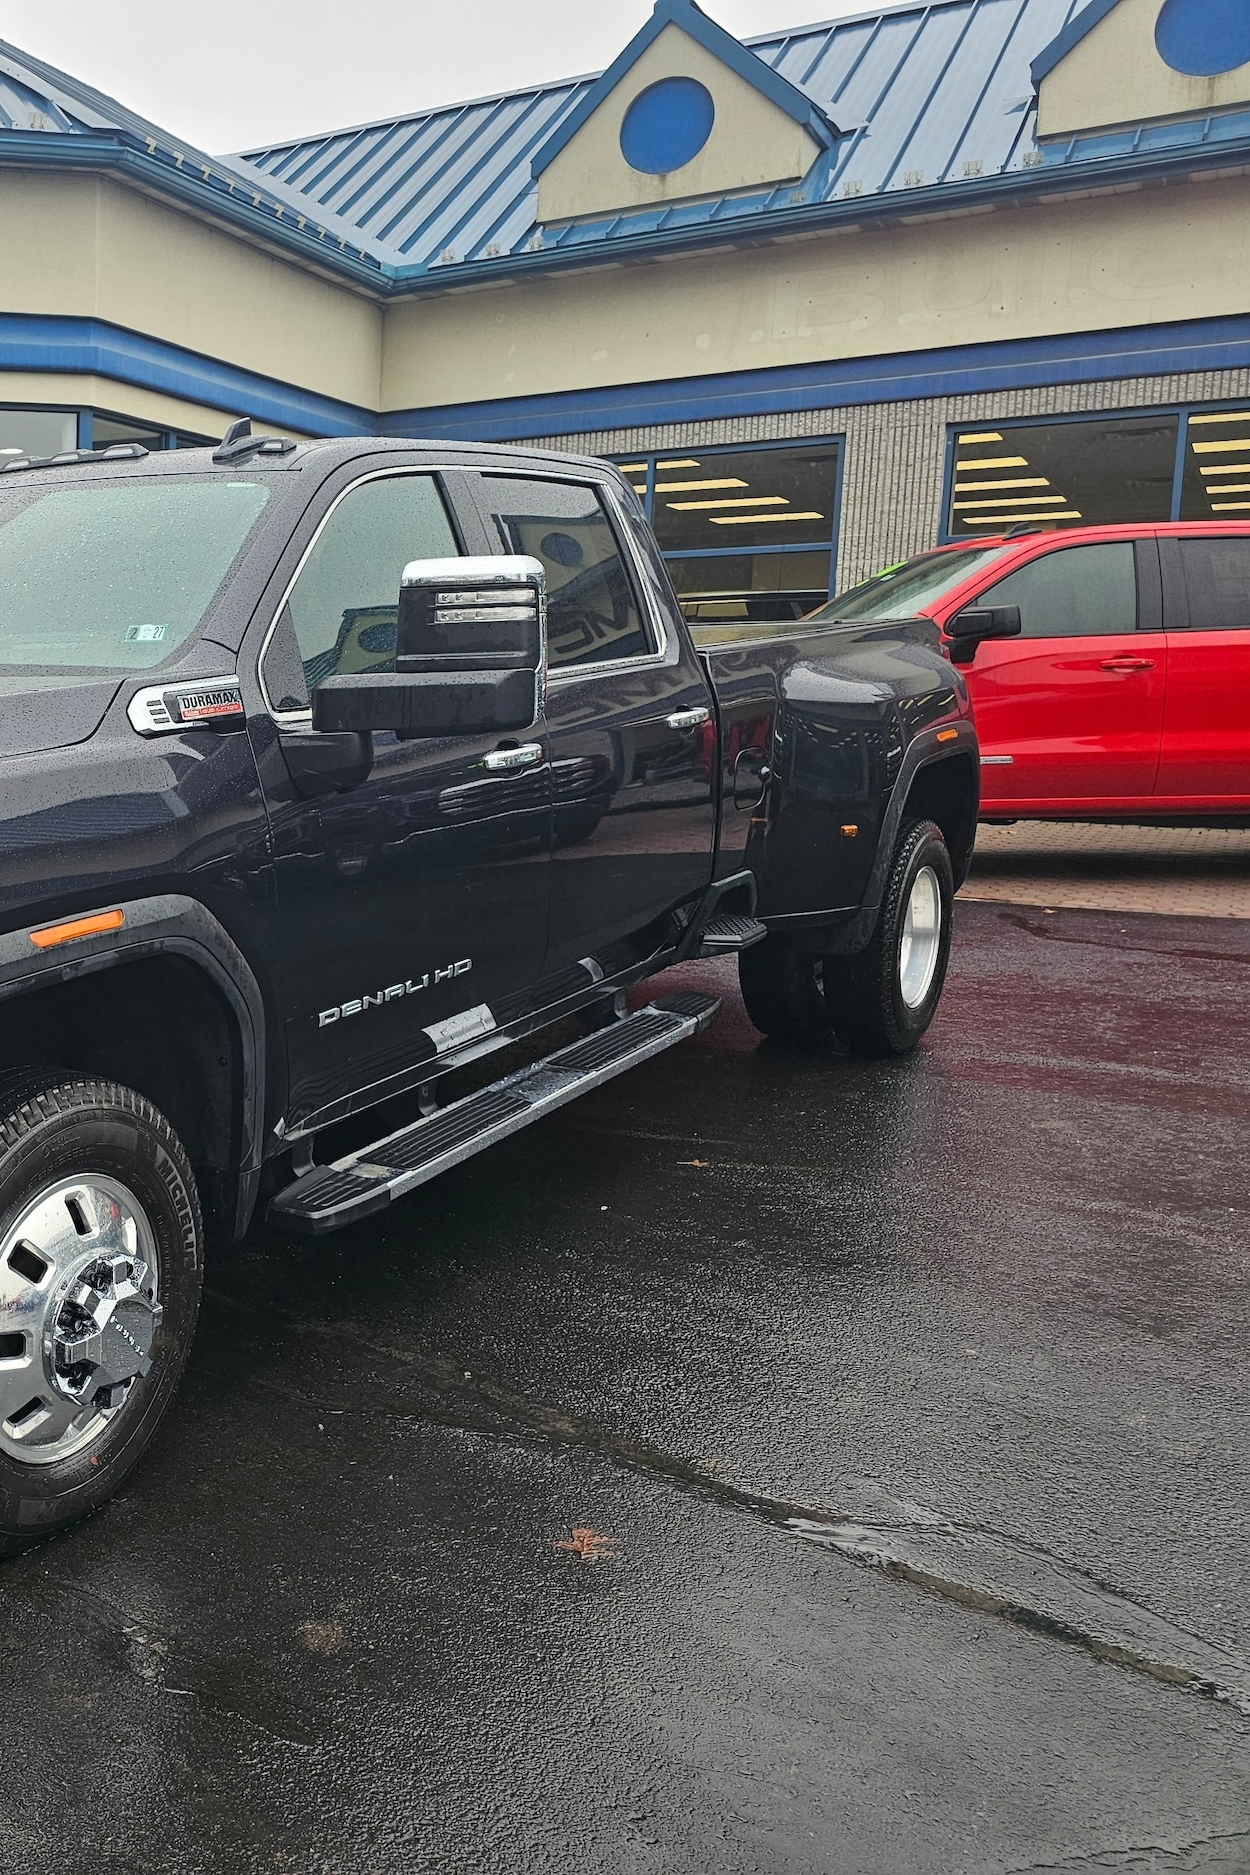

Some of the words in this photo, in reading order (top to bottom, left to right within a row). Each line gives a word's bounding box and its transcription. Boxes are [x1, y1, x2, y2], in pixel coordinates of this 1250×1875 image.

[152, 626, 164, 639] 27
[182, 690, 238, 709] DURAMAX
[318, 973, 430, 1028] DENALI
[434, 958, 473, 984] HD
[157, 1155, 195, 1271] MICHELIN
